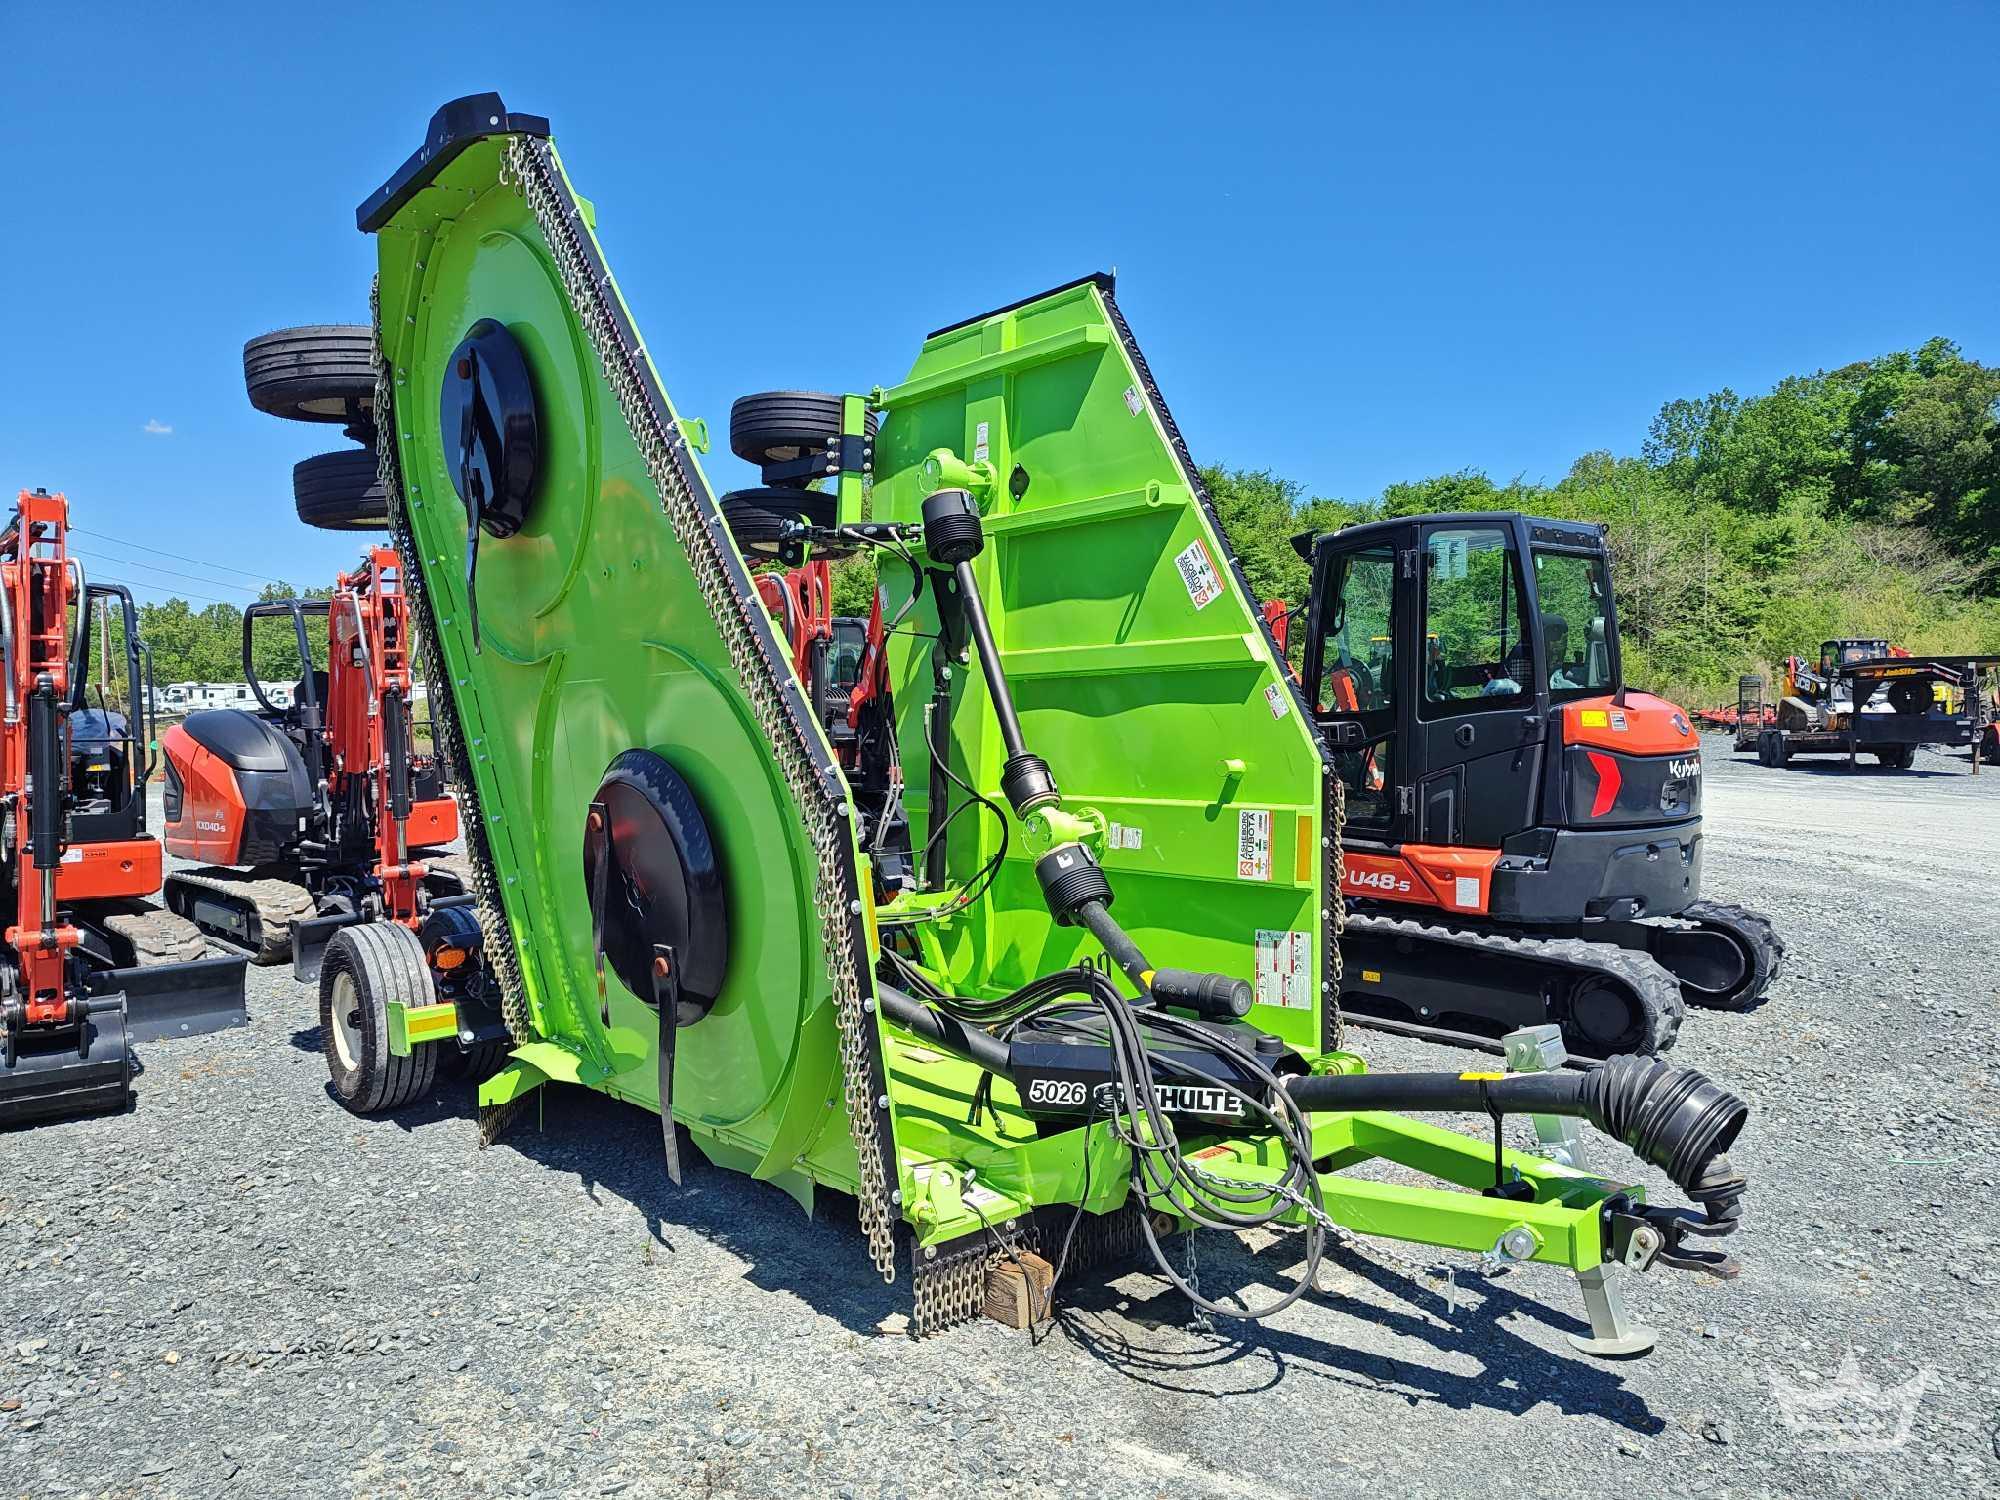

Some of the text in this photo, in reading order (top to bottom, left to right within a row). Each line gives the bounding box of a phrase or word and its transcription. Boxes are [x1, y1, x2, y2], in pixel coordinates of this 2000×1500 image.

[1183, 553, 1204, 591] KUBOTA
[1669, 759, 1700, 778] Kubota
[1240, 811, 1248, 859] ASHEBORO
[1247, 813, 1256, 860] KUBOTA
[1029, 1080, 1241, 1114] 5026 HULTE
